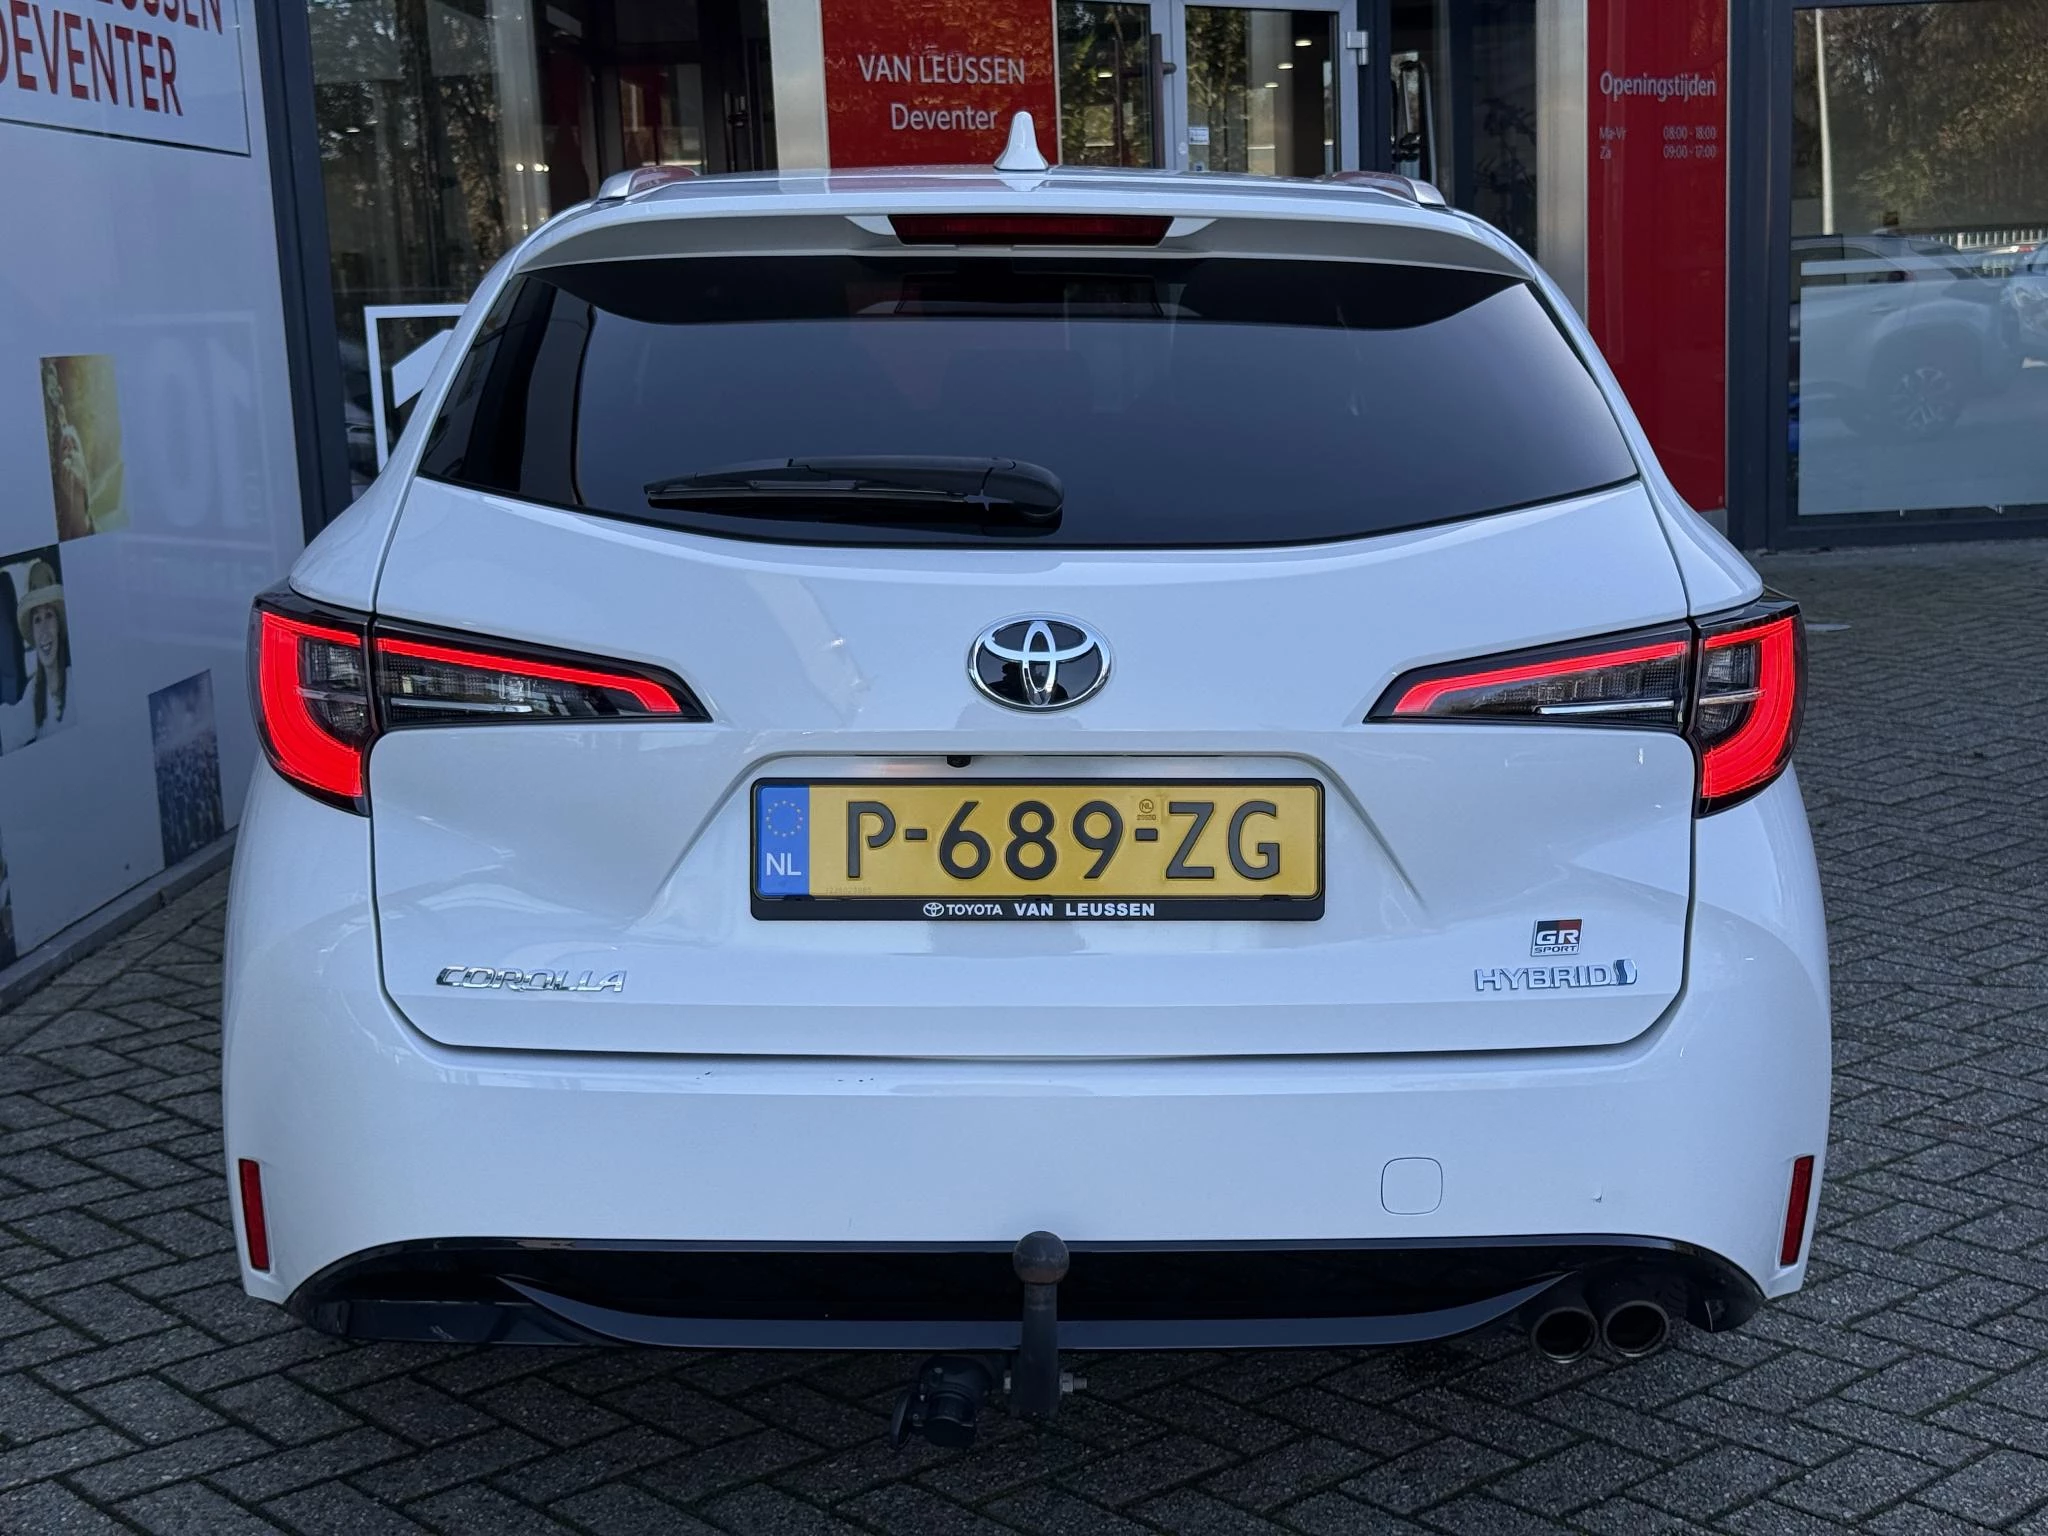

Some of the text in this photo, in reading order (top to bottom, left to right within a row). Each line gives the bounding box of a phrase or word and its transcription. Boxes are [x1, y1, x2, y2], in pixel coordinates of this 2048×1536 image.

[857, 55, 1026, 84] VAN LEUSSEN
[1600, 71, 1717, 102] Openingstijden
[891, 103, 998, 130] Deventer
[847, 800, 1280, 880] P-689-ZG
[766, 852, 802, 876] NL
[946, 903, 1155, 917] TOYOTA VAN LEUSSEN
[1533, 945, 1578, 954] SPORT
[1534, 929, 1580, 945] GR
[436, 965, 627, 992] COROLLA
[1474, 964, 1613, 991] HYBRID
